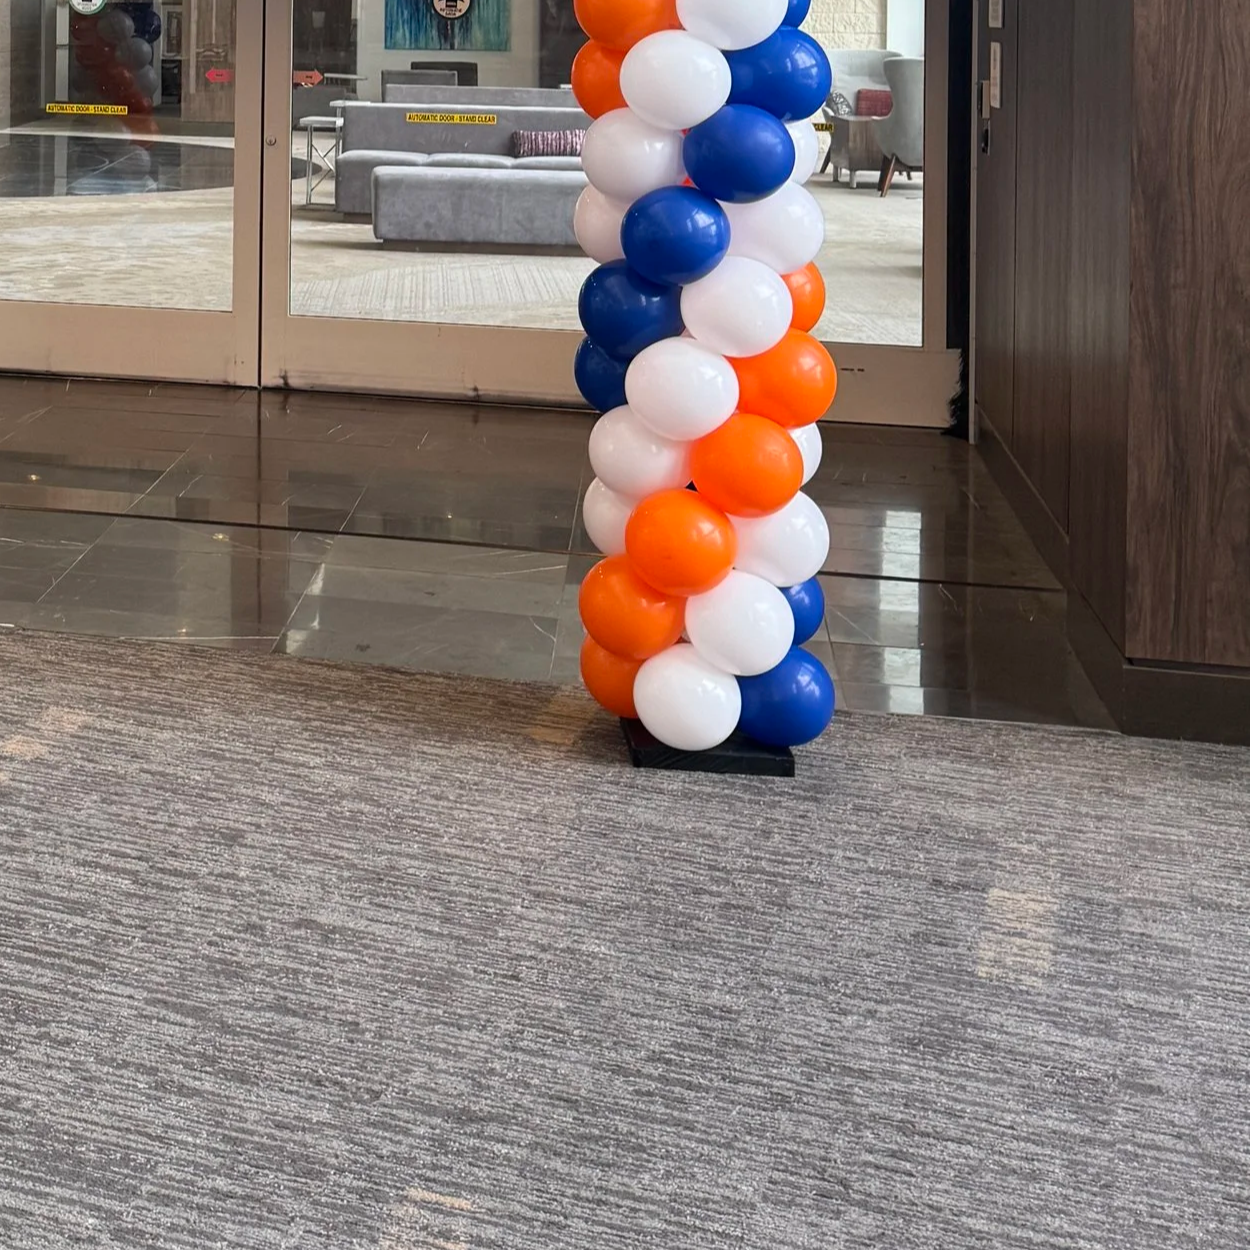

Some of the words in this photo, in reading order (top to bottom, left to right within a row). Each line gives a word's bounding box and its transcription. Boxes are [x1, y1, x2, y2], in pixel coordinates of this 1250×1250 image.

[111, 106, 127, 114] CLEAR
[408, 114, 438, 122] AUTOMATIC
[439, 114, 455, 122] DOOR
[459, 115, 476, 123] STAND
[477, 115, 496, 123] CLEAR
